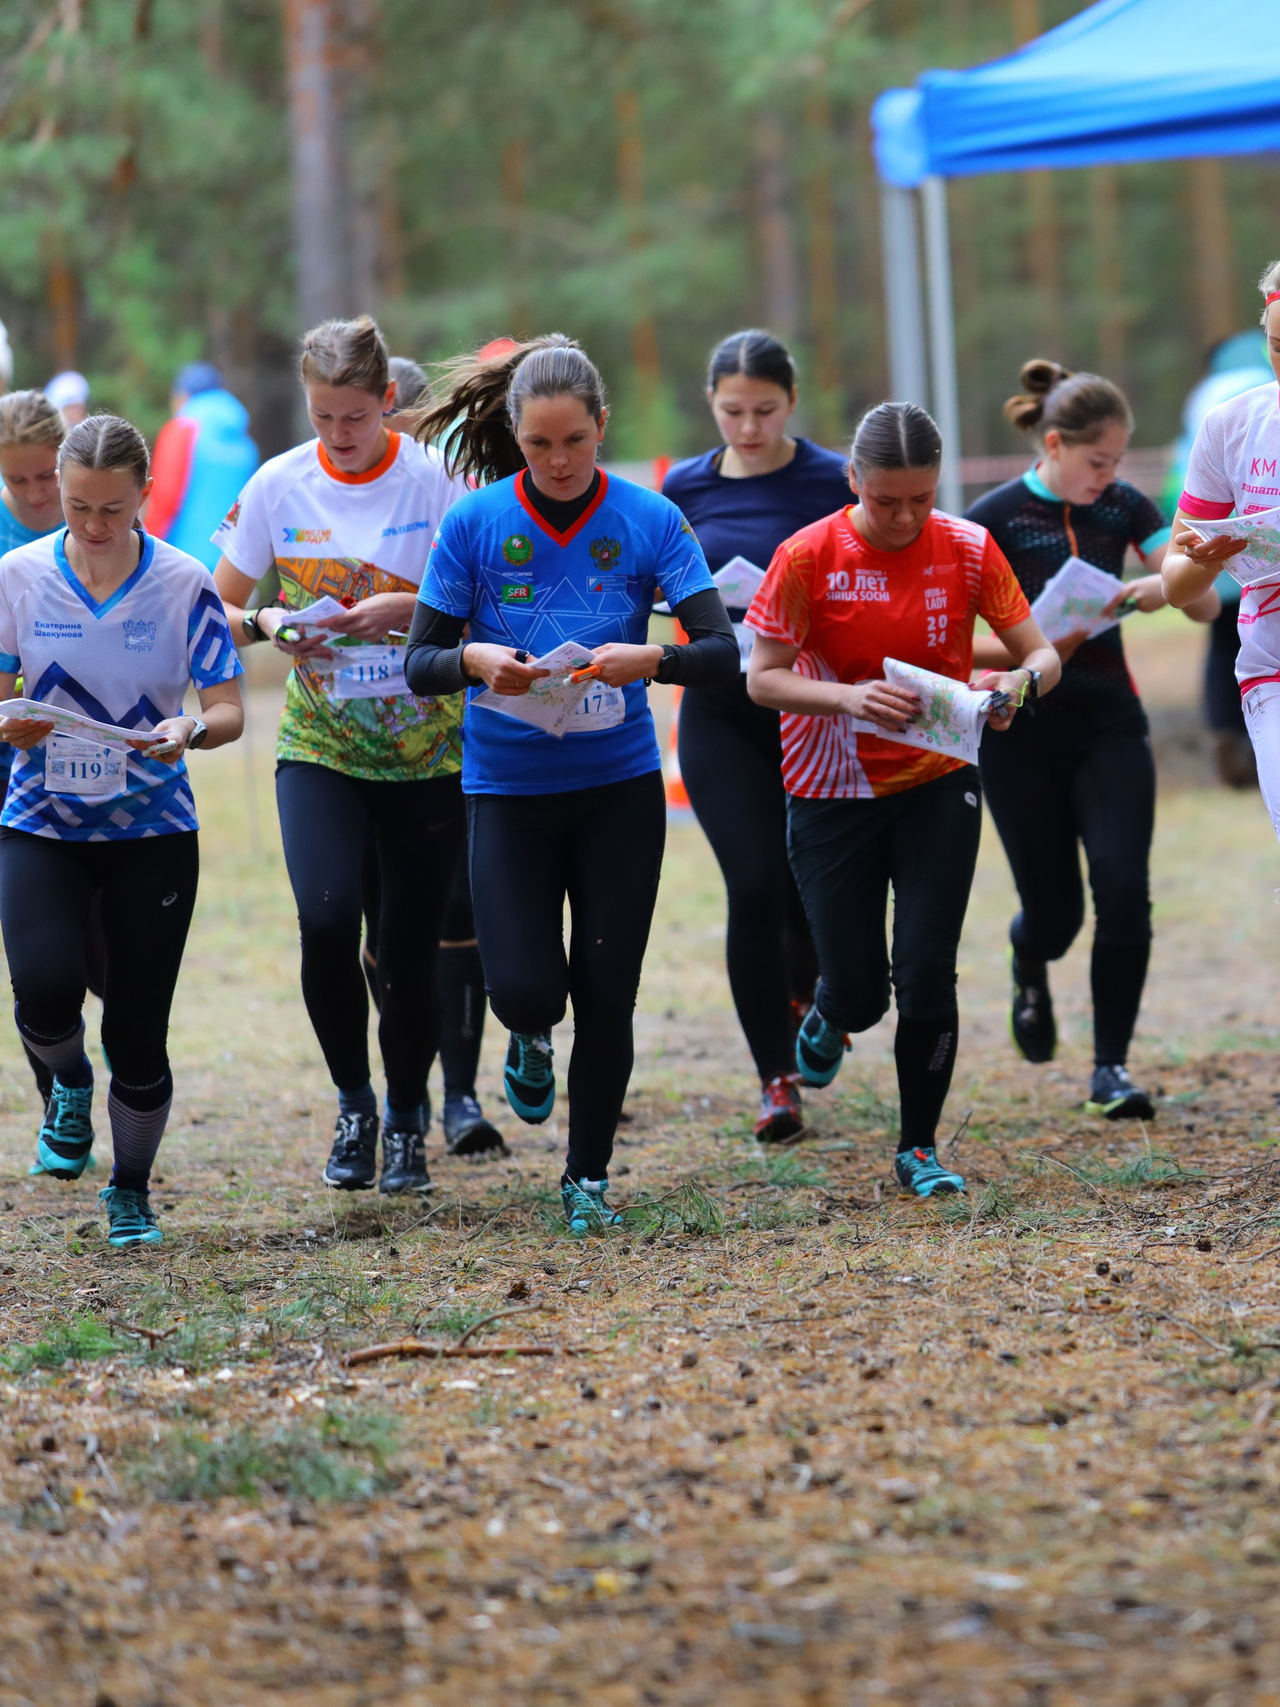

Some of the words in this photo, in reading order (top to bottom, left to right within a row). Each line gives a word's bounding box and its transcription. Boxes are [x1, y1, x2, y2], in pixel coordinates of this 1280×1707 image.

[1250, 457, 1277, 477] KM
[826, 571, 850, 591] 10
[854, 575, 888, 591] лет
[507, 587, 527, 597] SFR
[825, 590, 859, 601] SIRIUS
[860, 591, 890, 602] SOCHI
[925, 596, 948, 610] LADY
[34, 621, 82, 630] Екатерина
[34, 630, 83, 639] Шавкунова
[359, 664, 389, 682] 118
[575, 694, 603, 715] 17
[70, 761, 102, 780] 119
